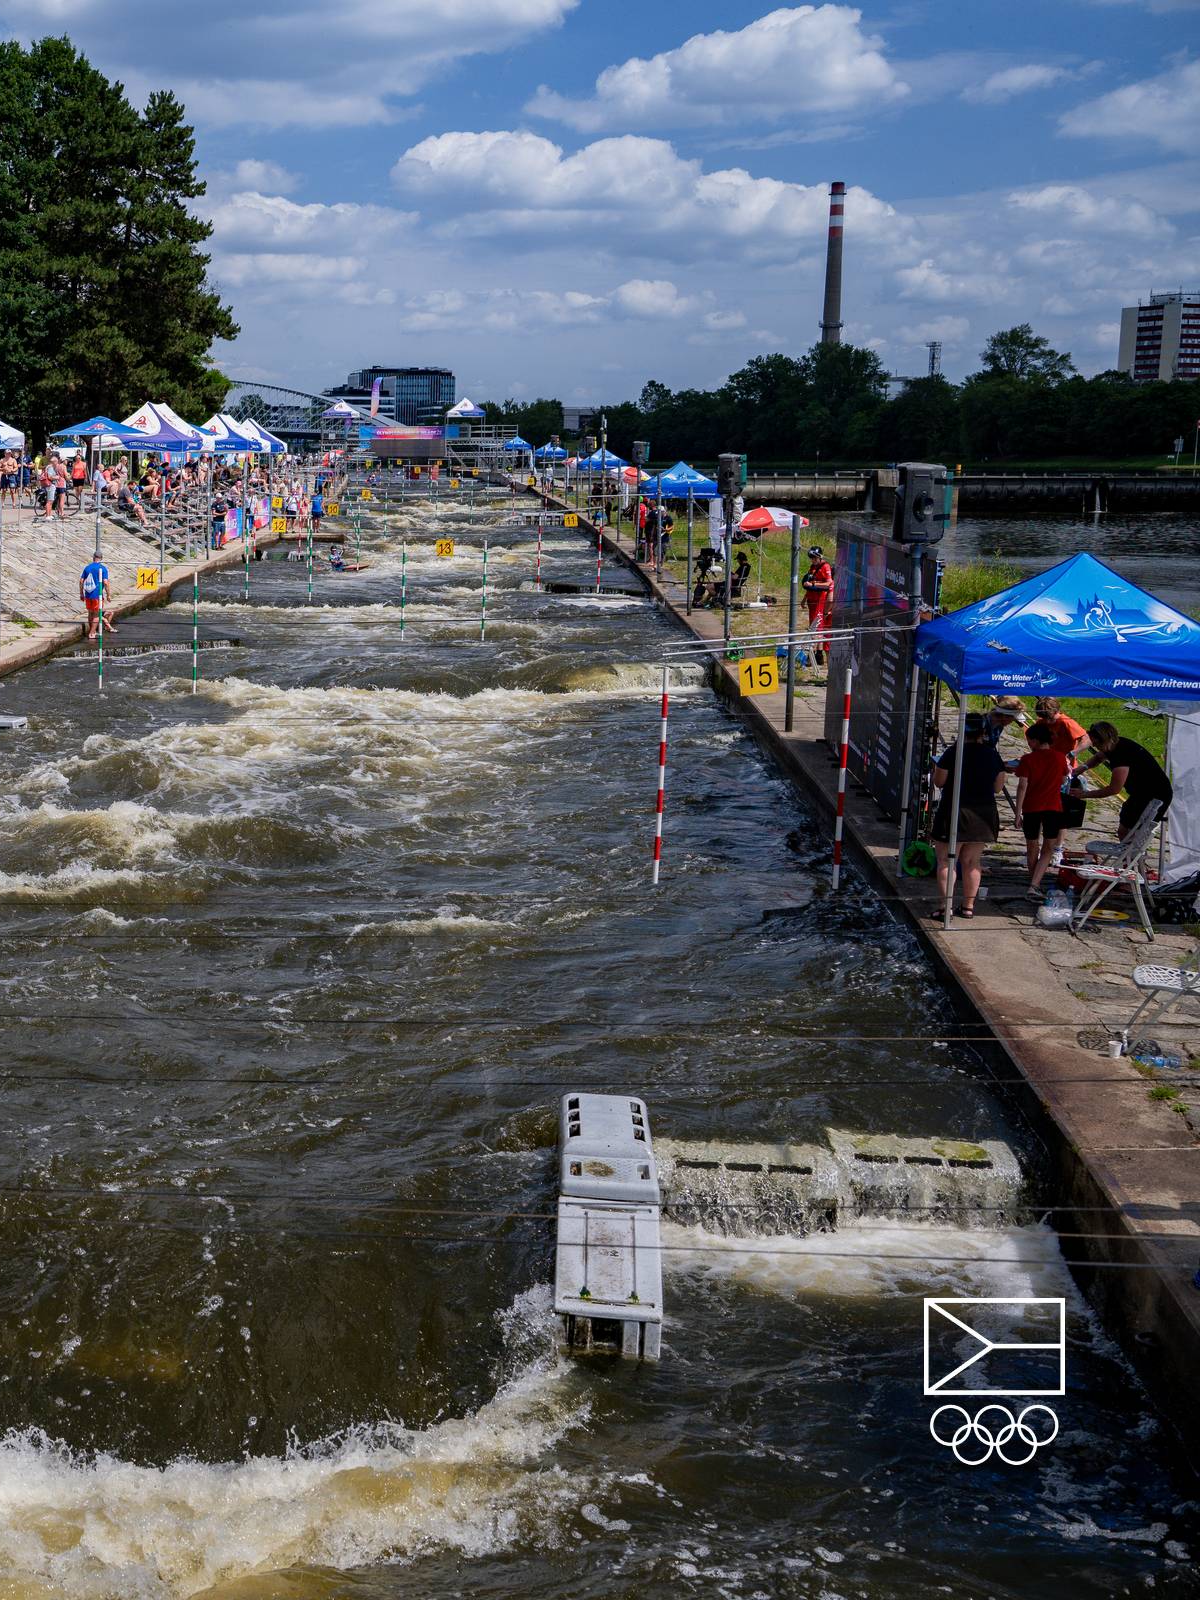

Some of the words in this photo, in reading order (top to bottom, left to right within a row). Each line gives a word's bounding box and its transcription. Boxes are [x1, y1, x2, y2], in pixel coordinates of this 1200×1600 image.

[329, 505, 338, 515] 10
[274, 521, 285, 531] 12
[439, 542, 452, 554] 13
[140, 572, 155, 587] 14
[744, 663, 773, 689] 15
[991, 673, 1012, 682] White
[1012, 674, 1033, 682] Water
